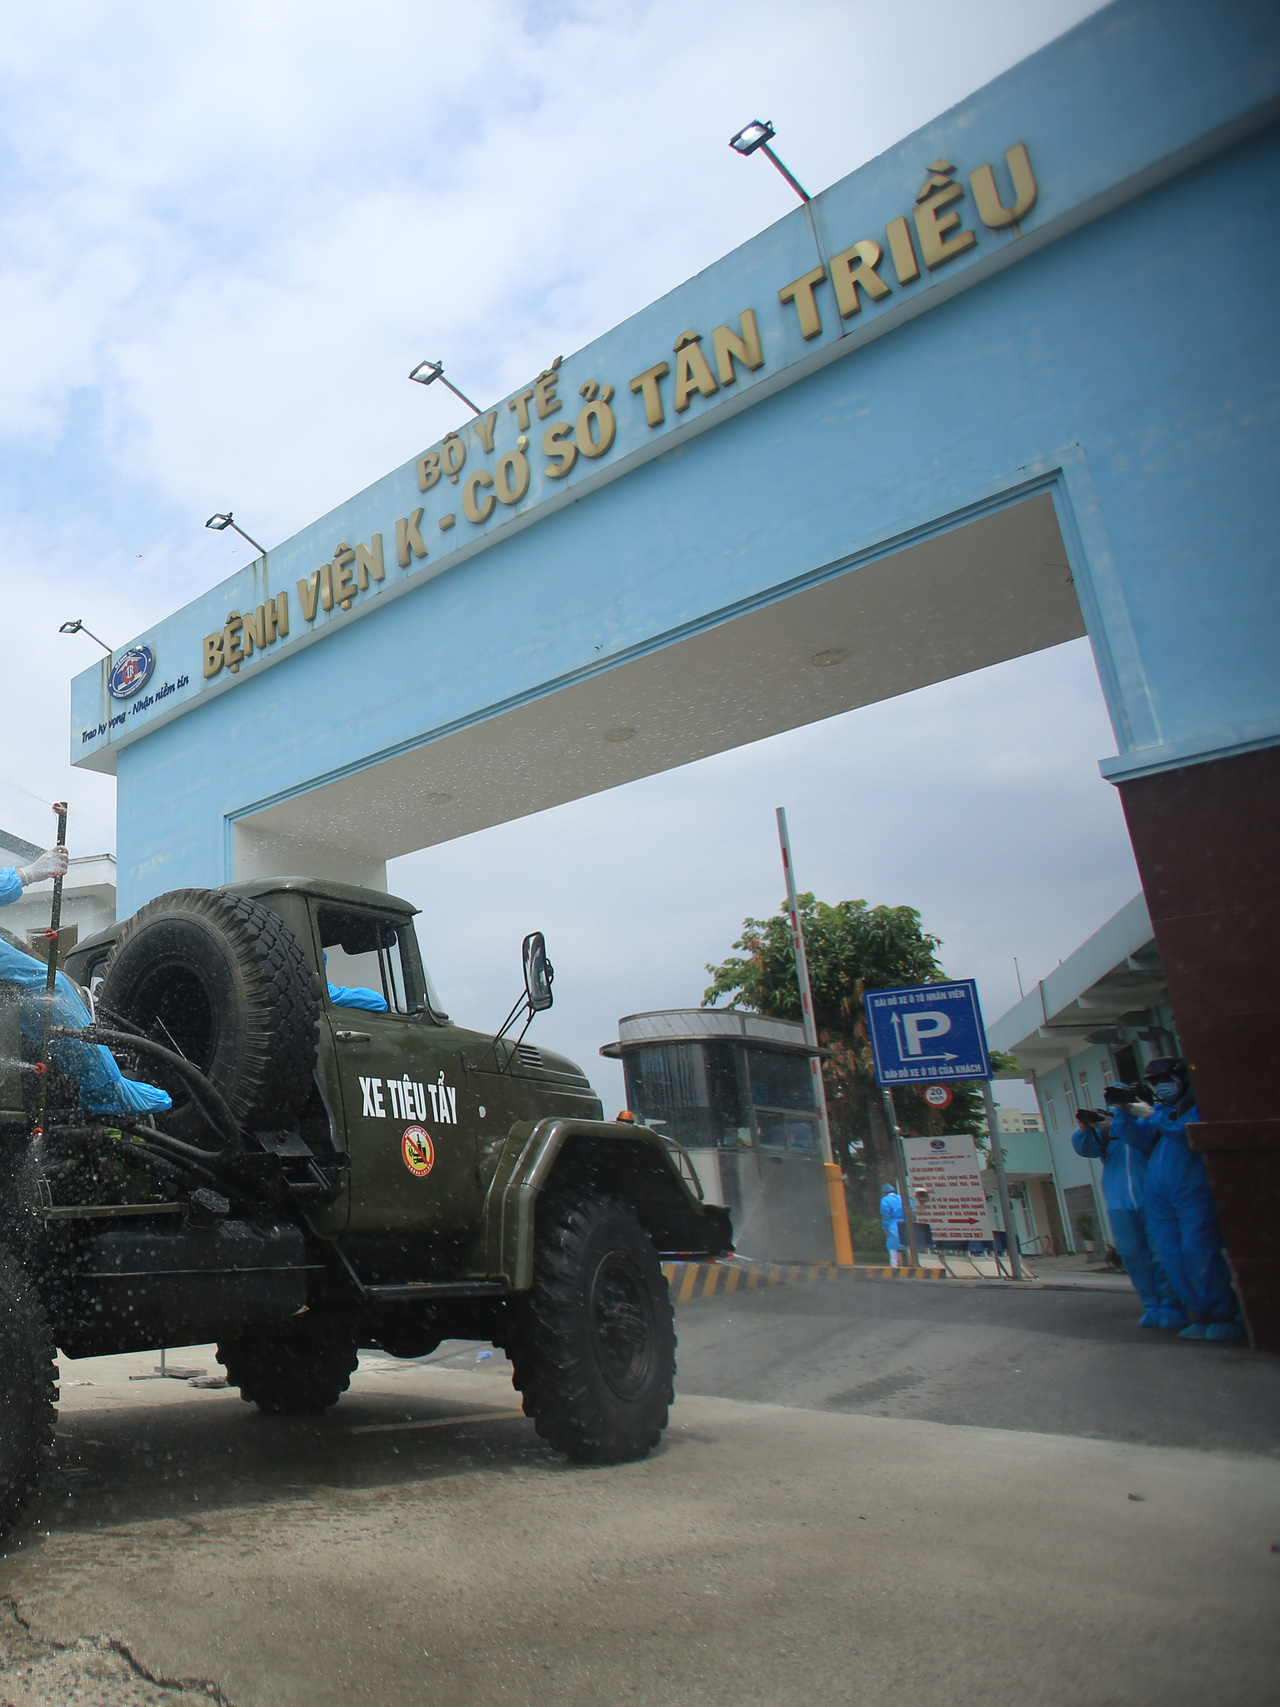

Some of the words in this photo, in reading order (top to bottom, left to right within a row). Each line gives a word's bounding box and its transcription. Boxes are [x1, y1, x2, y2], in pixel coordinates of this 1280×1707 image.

[202, 591, 289, 680] BỆNH
[296, 533, 385, 622] VIỆN
[395, 507, 429, 569] K
[462, 435, 530, 524] CƠ
[542, 380, 617, 480] SỞ
[629, 307, 766, 428] TÂN
[778, 142, 1039, 341] TRIỀU
[416, 431, 466, 493] BỘ
[472, 410, 498, 454] Y
[508, 354, 564, 432] TẾ
[132, 696, 154, 715] Nhận
[898, 995, 909, 1005] XE
[902, 1011, 952, 1055] P
[909, 1068, 920, 1077] XE
[938, 1063, 954, 1075] CỦA
[954, 1062, 982, 1074] KHÁCH
[358, 1076, 387, 1118] XE
[386, 1073, 427, 1122] TIÊU
[427, 1070, 458, 1125] TẨY
